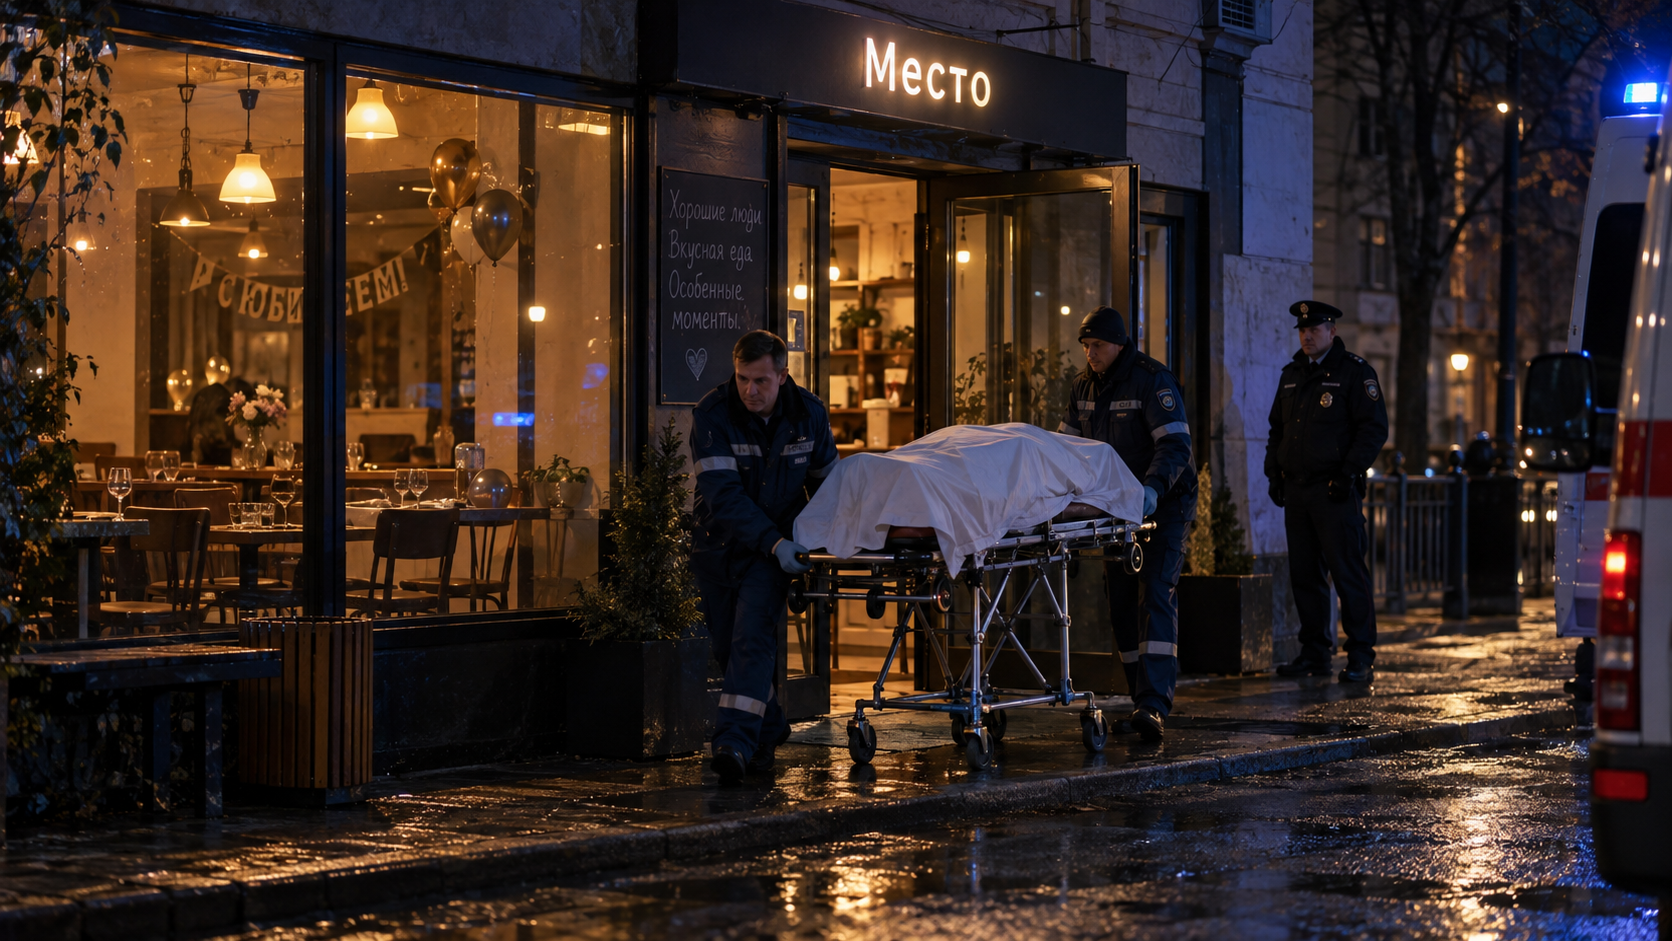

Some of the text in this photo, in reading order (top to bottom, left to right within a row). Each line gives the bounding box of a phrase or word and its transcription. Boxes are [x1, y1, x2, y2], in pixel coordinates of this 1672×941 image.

[865, 36, 991, 108] Место
[669, 188, 763, 233] Хорошие люди
[668, 228, 725, 270] Вкусная
[668, 269, 745, 301] Особенные
[671, 310, 741, 330] моменты.
